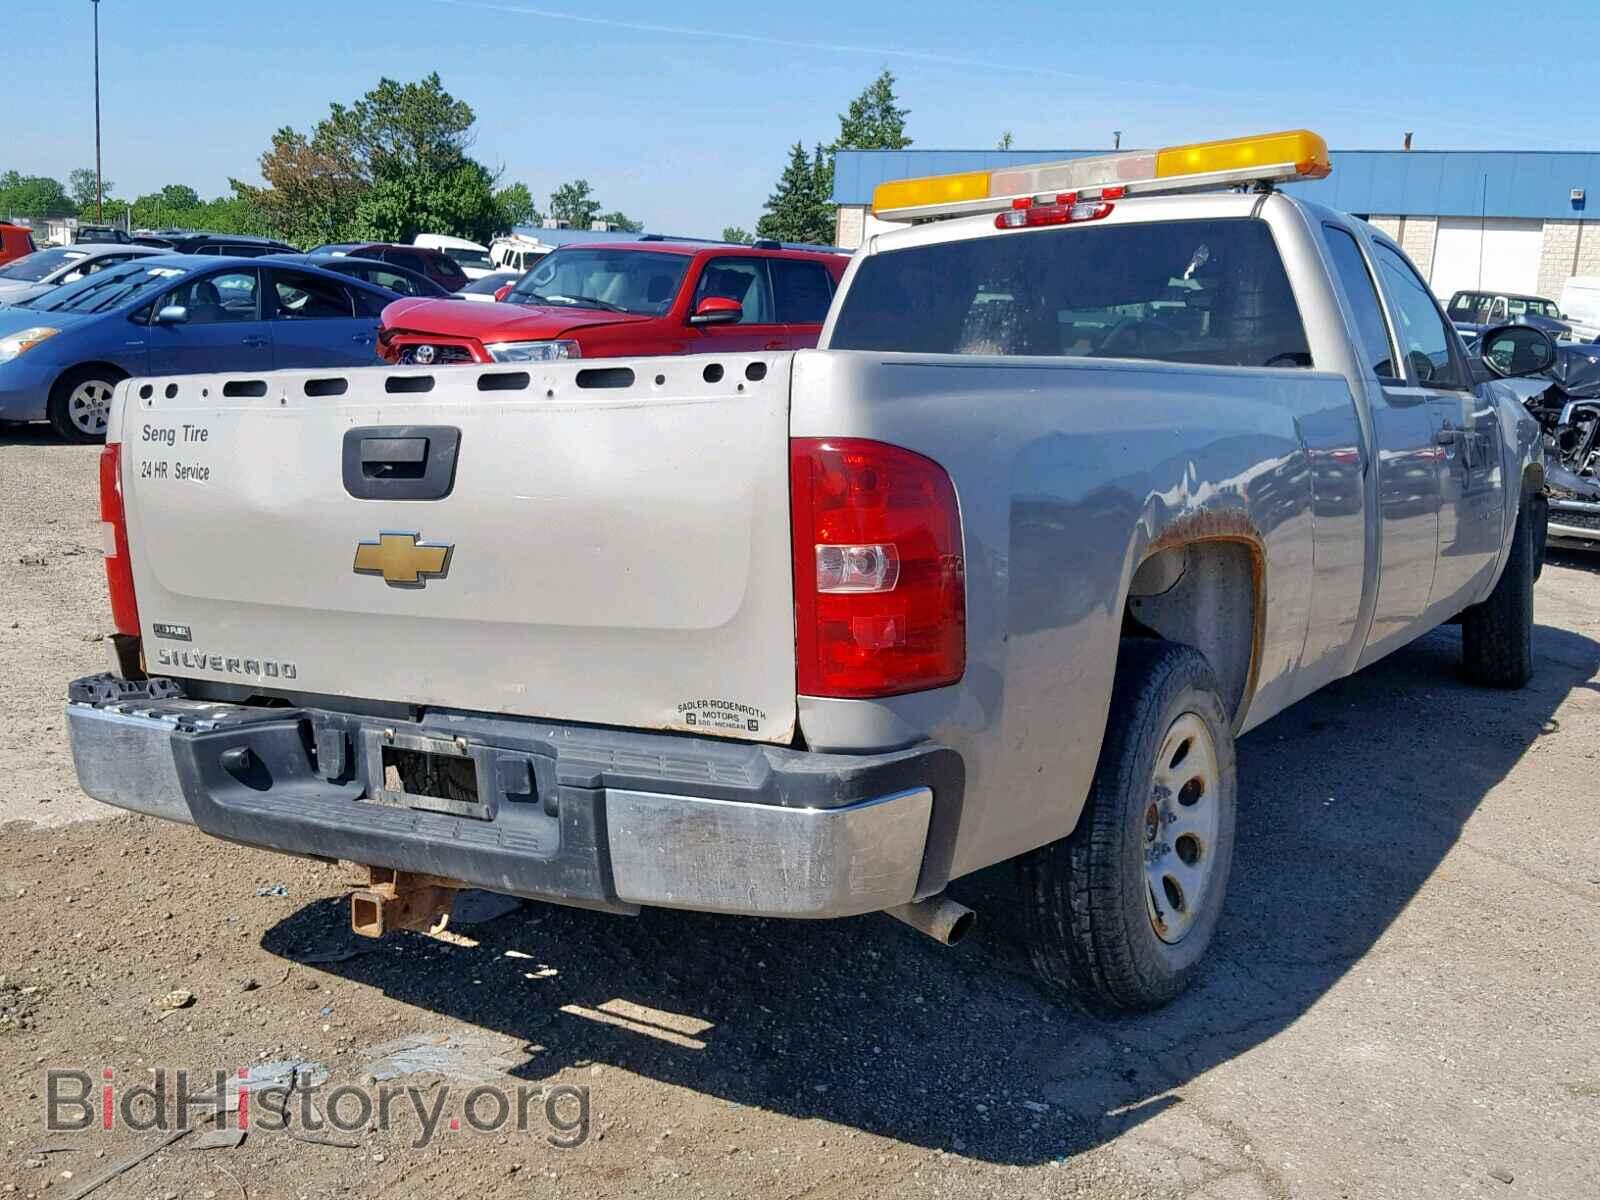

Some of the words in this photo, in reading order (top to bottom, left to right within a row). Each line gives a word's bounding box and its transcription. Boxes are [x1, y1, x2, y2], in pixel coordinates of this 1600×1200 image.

[142, 424, 176, 447] Seng
[182, 424, 209, 442] Tire
[141, 460, 152, 479] 24
[154, 461, 168, 479] HR
[174, 461, 210, 481] Service
[157, 648, 297, 680] SILVERADO
[702, 711, 740, 722] MOTORS
